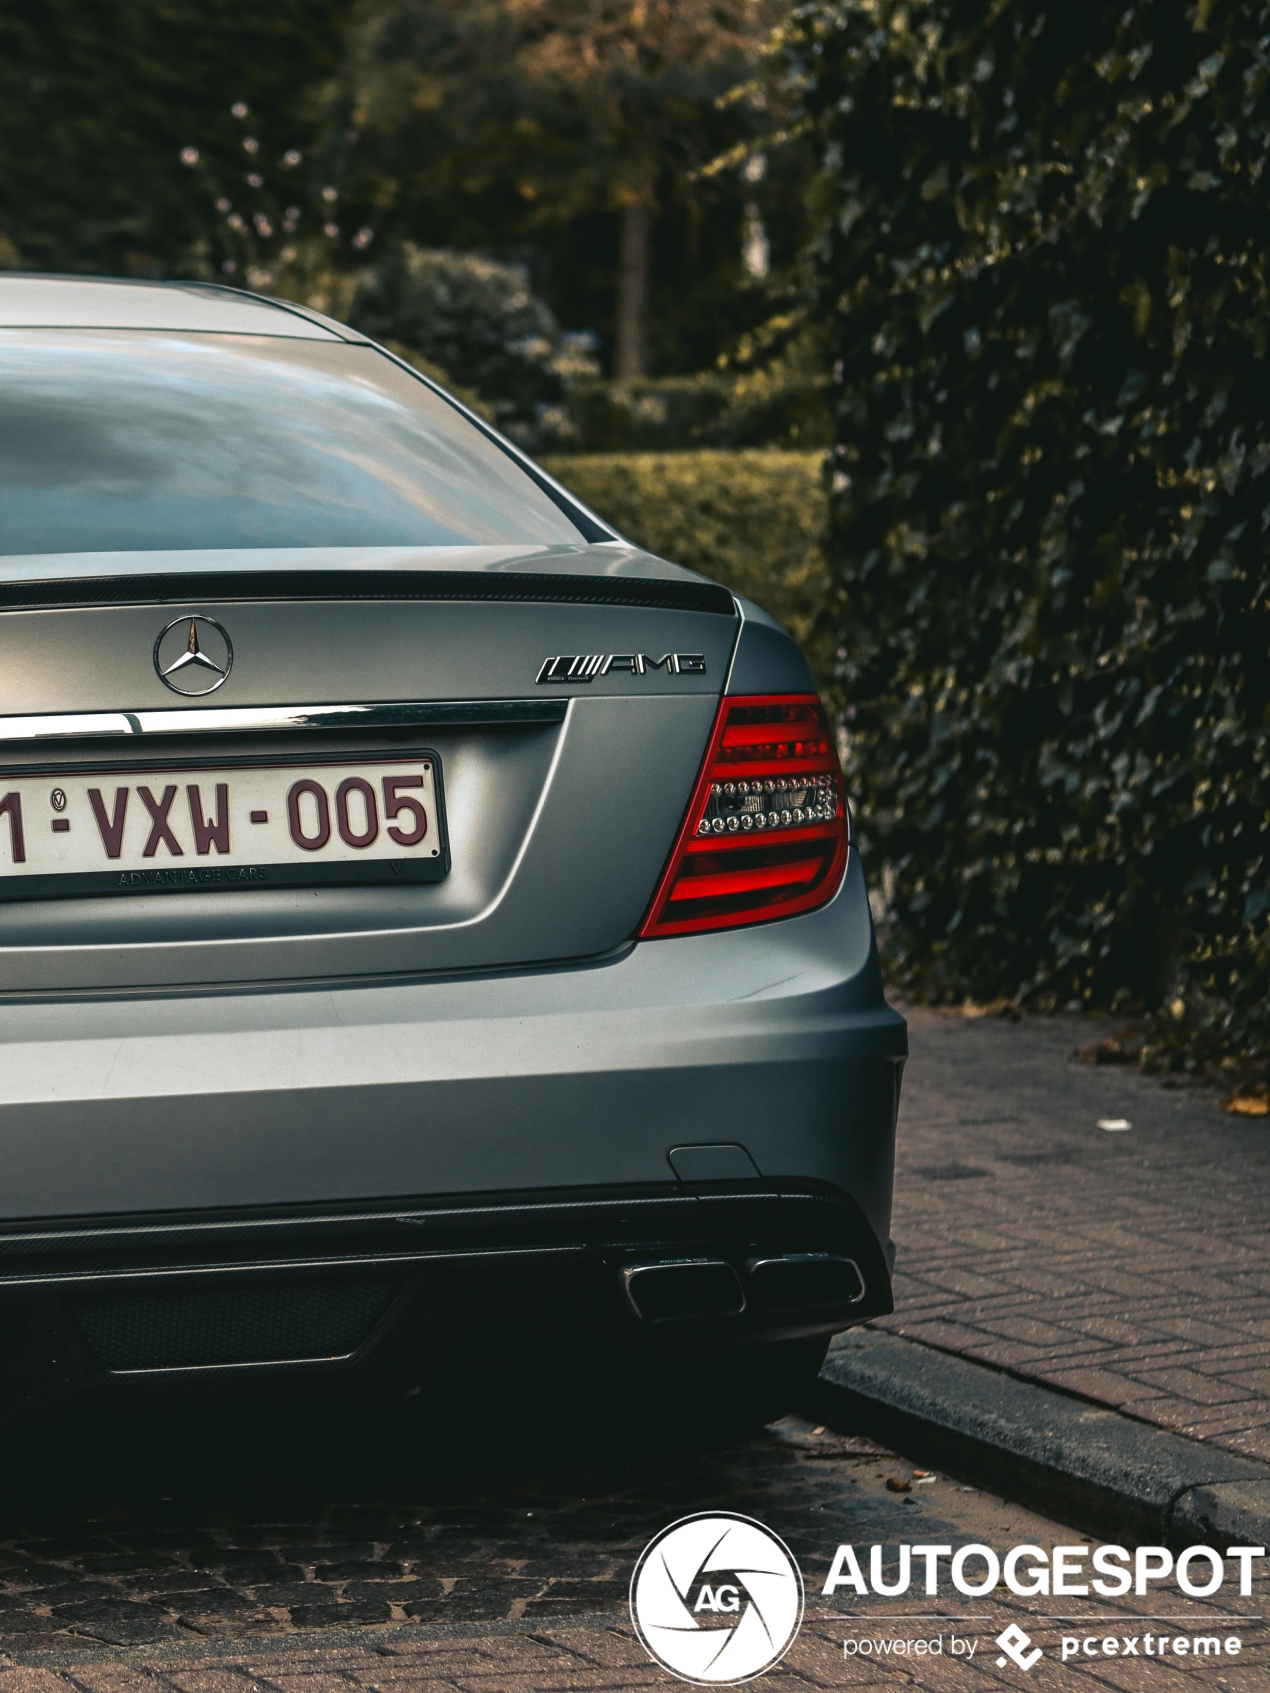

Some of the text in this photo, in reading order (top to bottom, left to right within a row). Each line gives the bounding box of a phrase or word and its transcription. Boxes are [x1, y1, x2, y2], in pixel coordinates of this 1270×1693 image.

[600, 653, 707, 676] AMG
[118, 866, 268, 887] ADVANTAGE CARS
